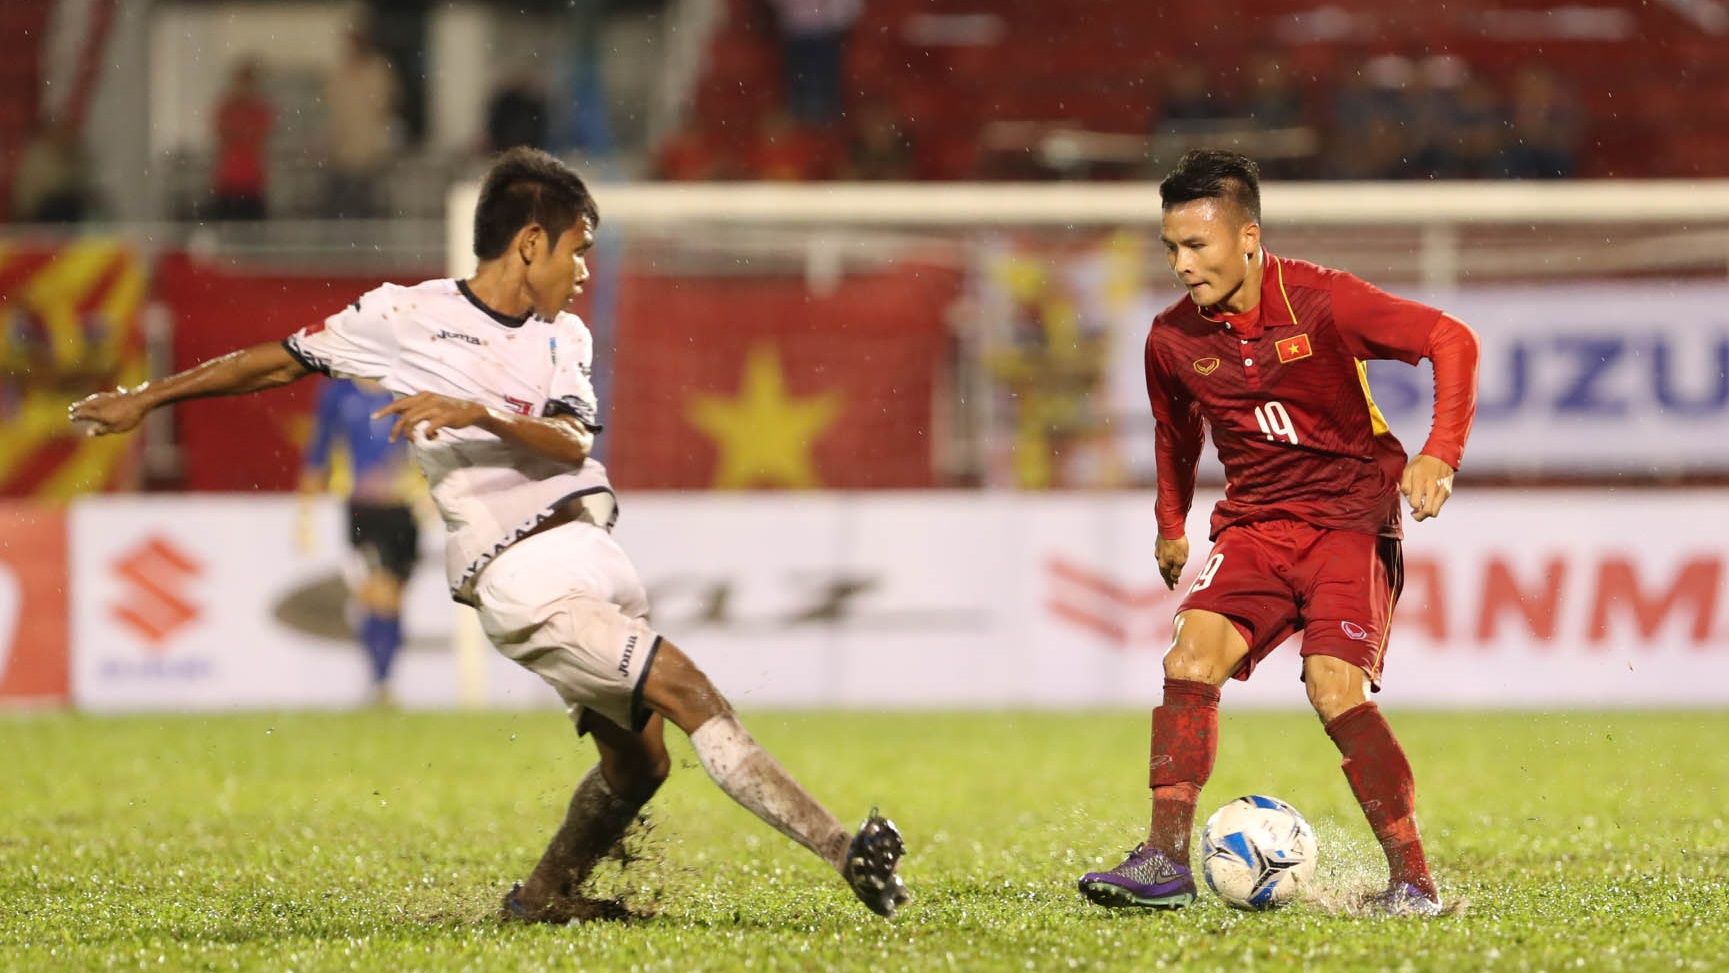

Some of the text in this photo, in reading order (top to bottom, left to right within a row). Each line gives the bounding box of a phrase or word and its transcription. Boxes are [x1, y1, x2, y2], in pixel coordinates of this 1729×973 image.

[1254, 401, 1299, 445] 19
[1188, 552, 1225, 593] 9
[1402, 552, 1729, 643] ANM
[618, 635, 639, 678] Joma
